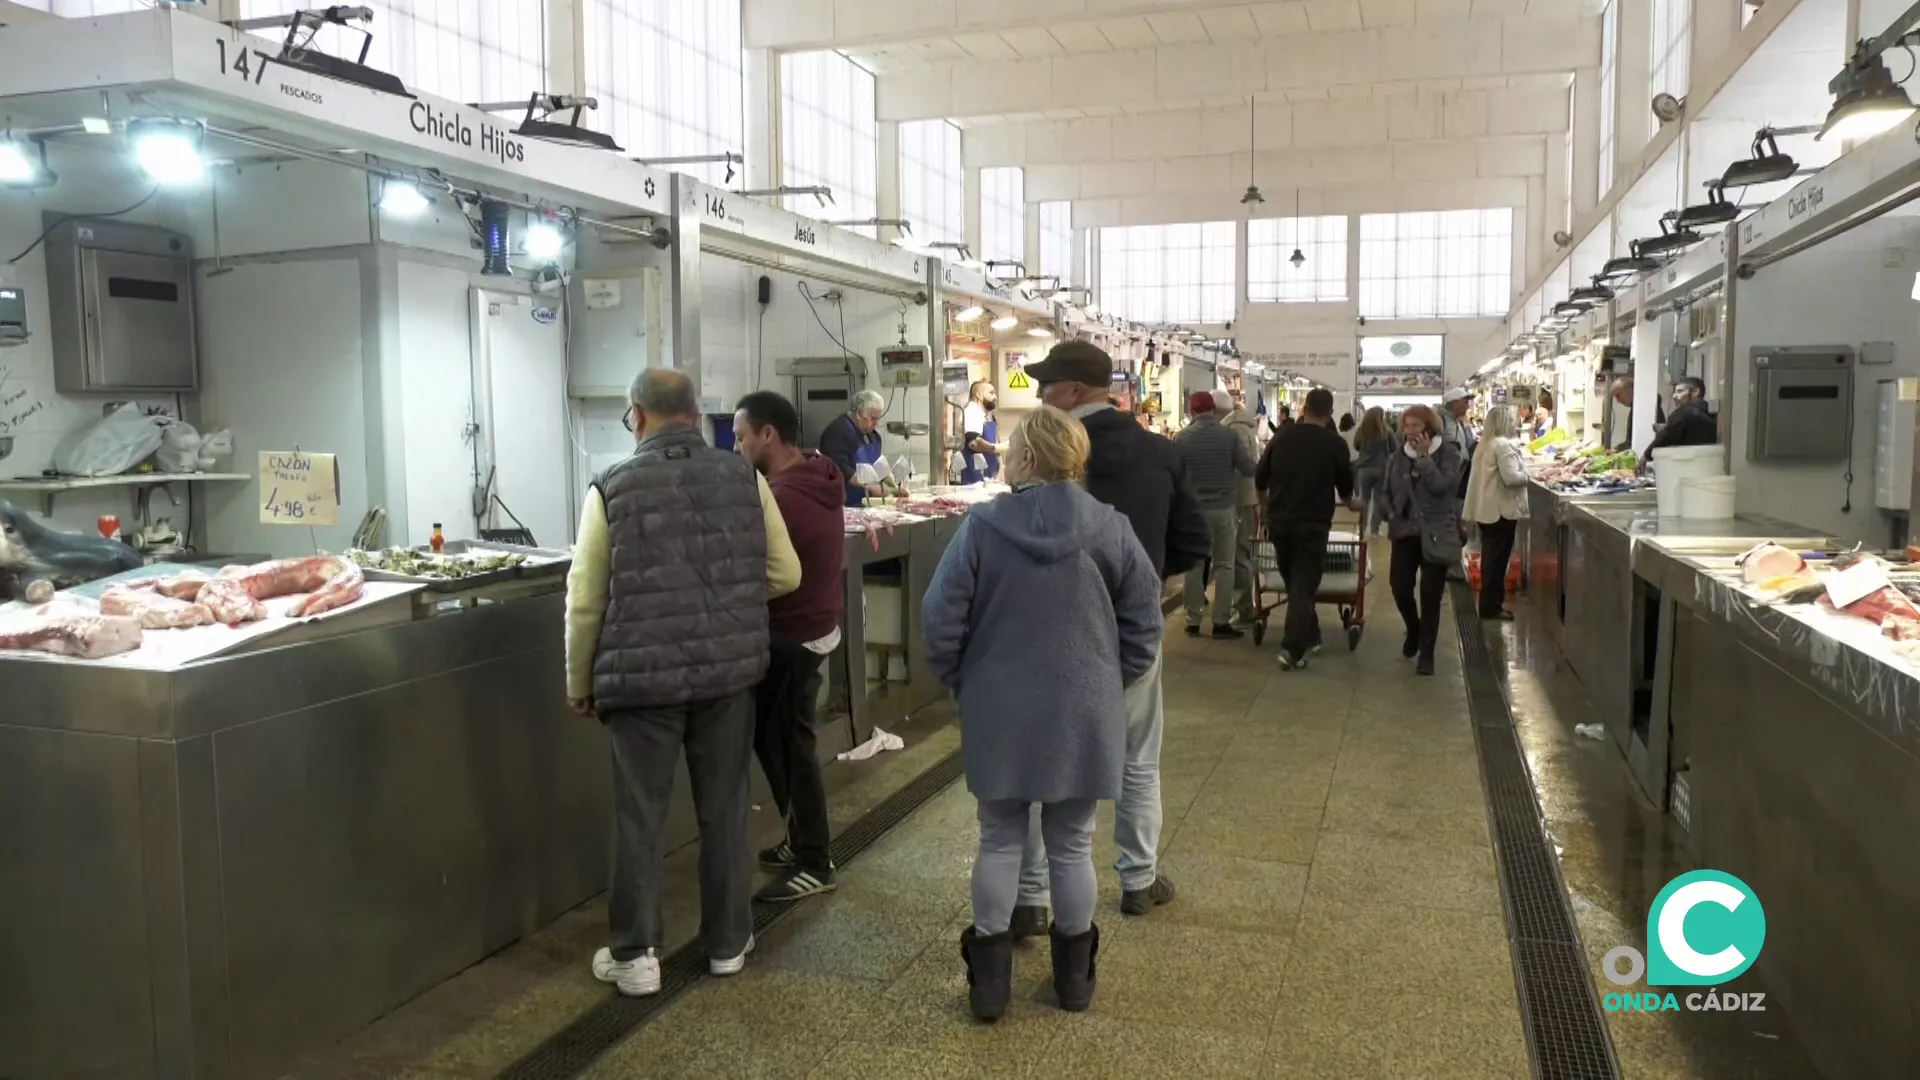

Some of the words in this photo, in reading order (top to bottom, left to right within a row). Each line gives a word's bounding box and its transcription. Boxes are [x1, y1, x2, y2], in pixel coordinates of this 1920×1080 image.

[216, 38, 269, 86] 147
[280, 83, 323, 105] PESCADOS
[409, 100, 472, 147] Chicla
[480, 123, 525, 164] Hijos
[705, 192, 725, 220] 146
[794, 220, 816, 246] Jesús
[942, 266, 952, 284] 145
